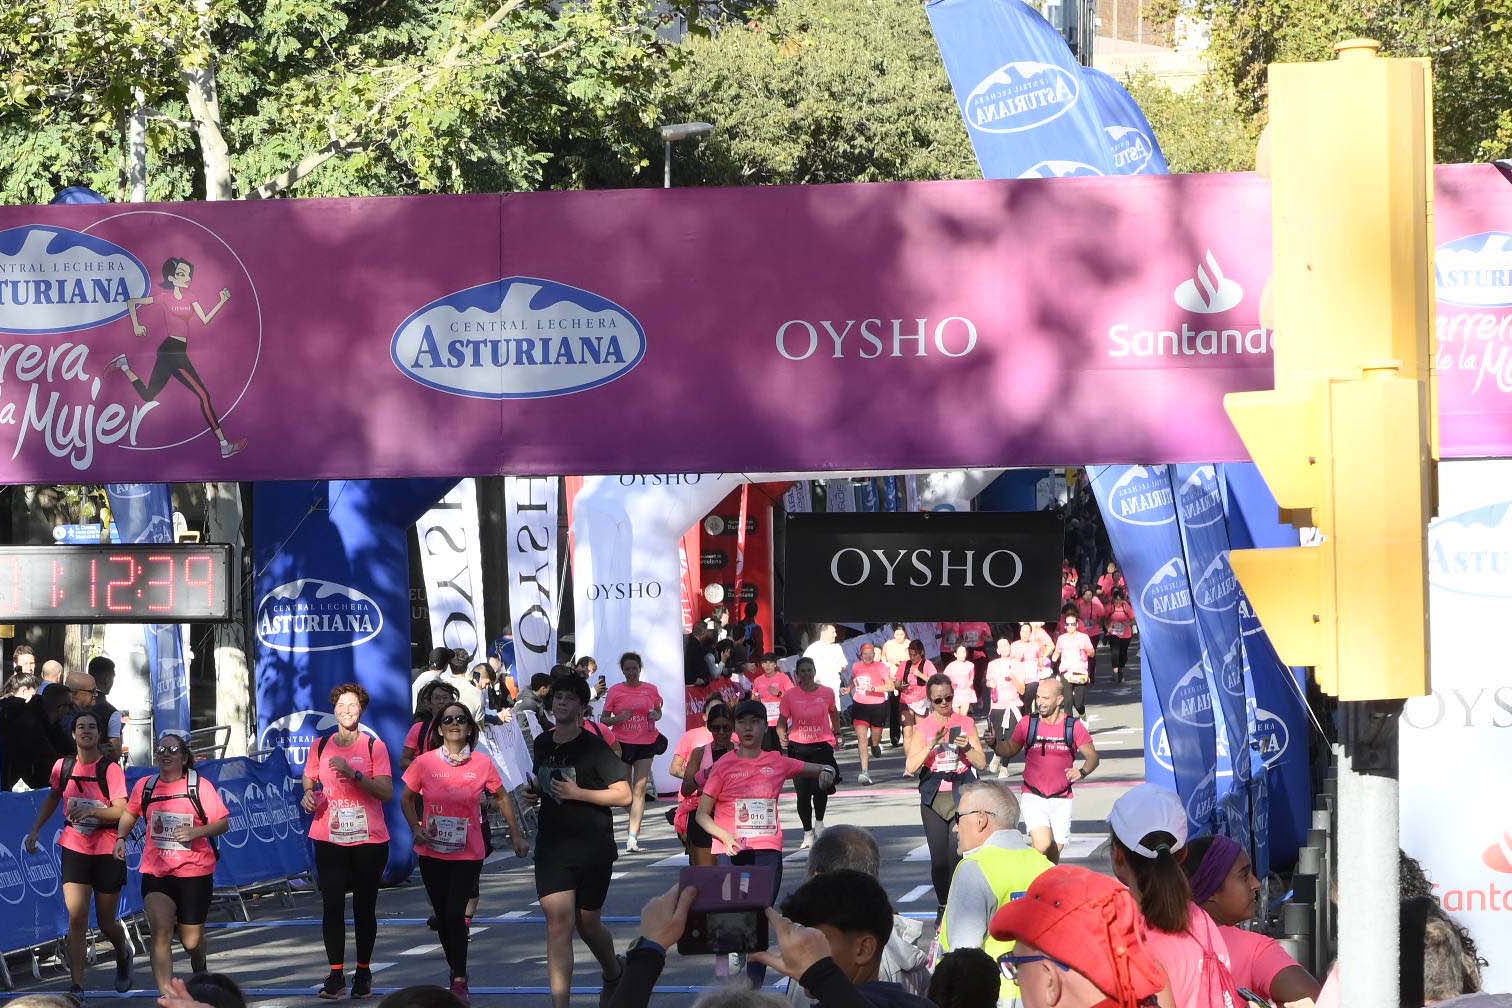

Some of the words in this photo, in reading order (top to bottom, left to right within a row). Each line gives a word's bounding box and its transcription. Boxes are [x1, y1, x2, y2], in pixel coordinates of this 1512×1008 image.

[51, 261, 126, 273] LECHERA
[450, 319, 528, 333] CENTRAL
[536, 317, 618, 331] LECHERA
[774, 316, 978, 361] OYSHO
[411, 324, 627, 370] ASTURIANA
[11, 376, 161, 471] Mujer
[619, 472, 701, 486] OYSHO
[829, 547, 1023, 588] OYSHO
[586, 581, 662, 601] OYSHO
[273, 603, 316, 613] CENTRAL
[319, 602, 369, 612] LECHERA
[261, 608, 374, 636] ASTURIANA
[1404, 684, 1512, 730] OYS
